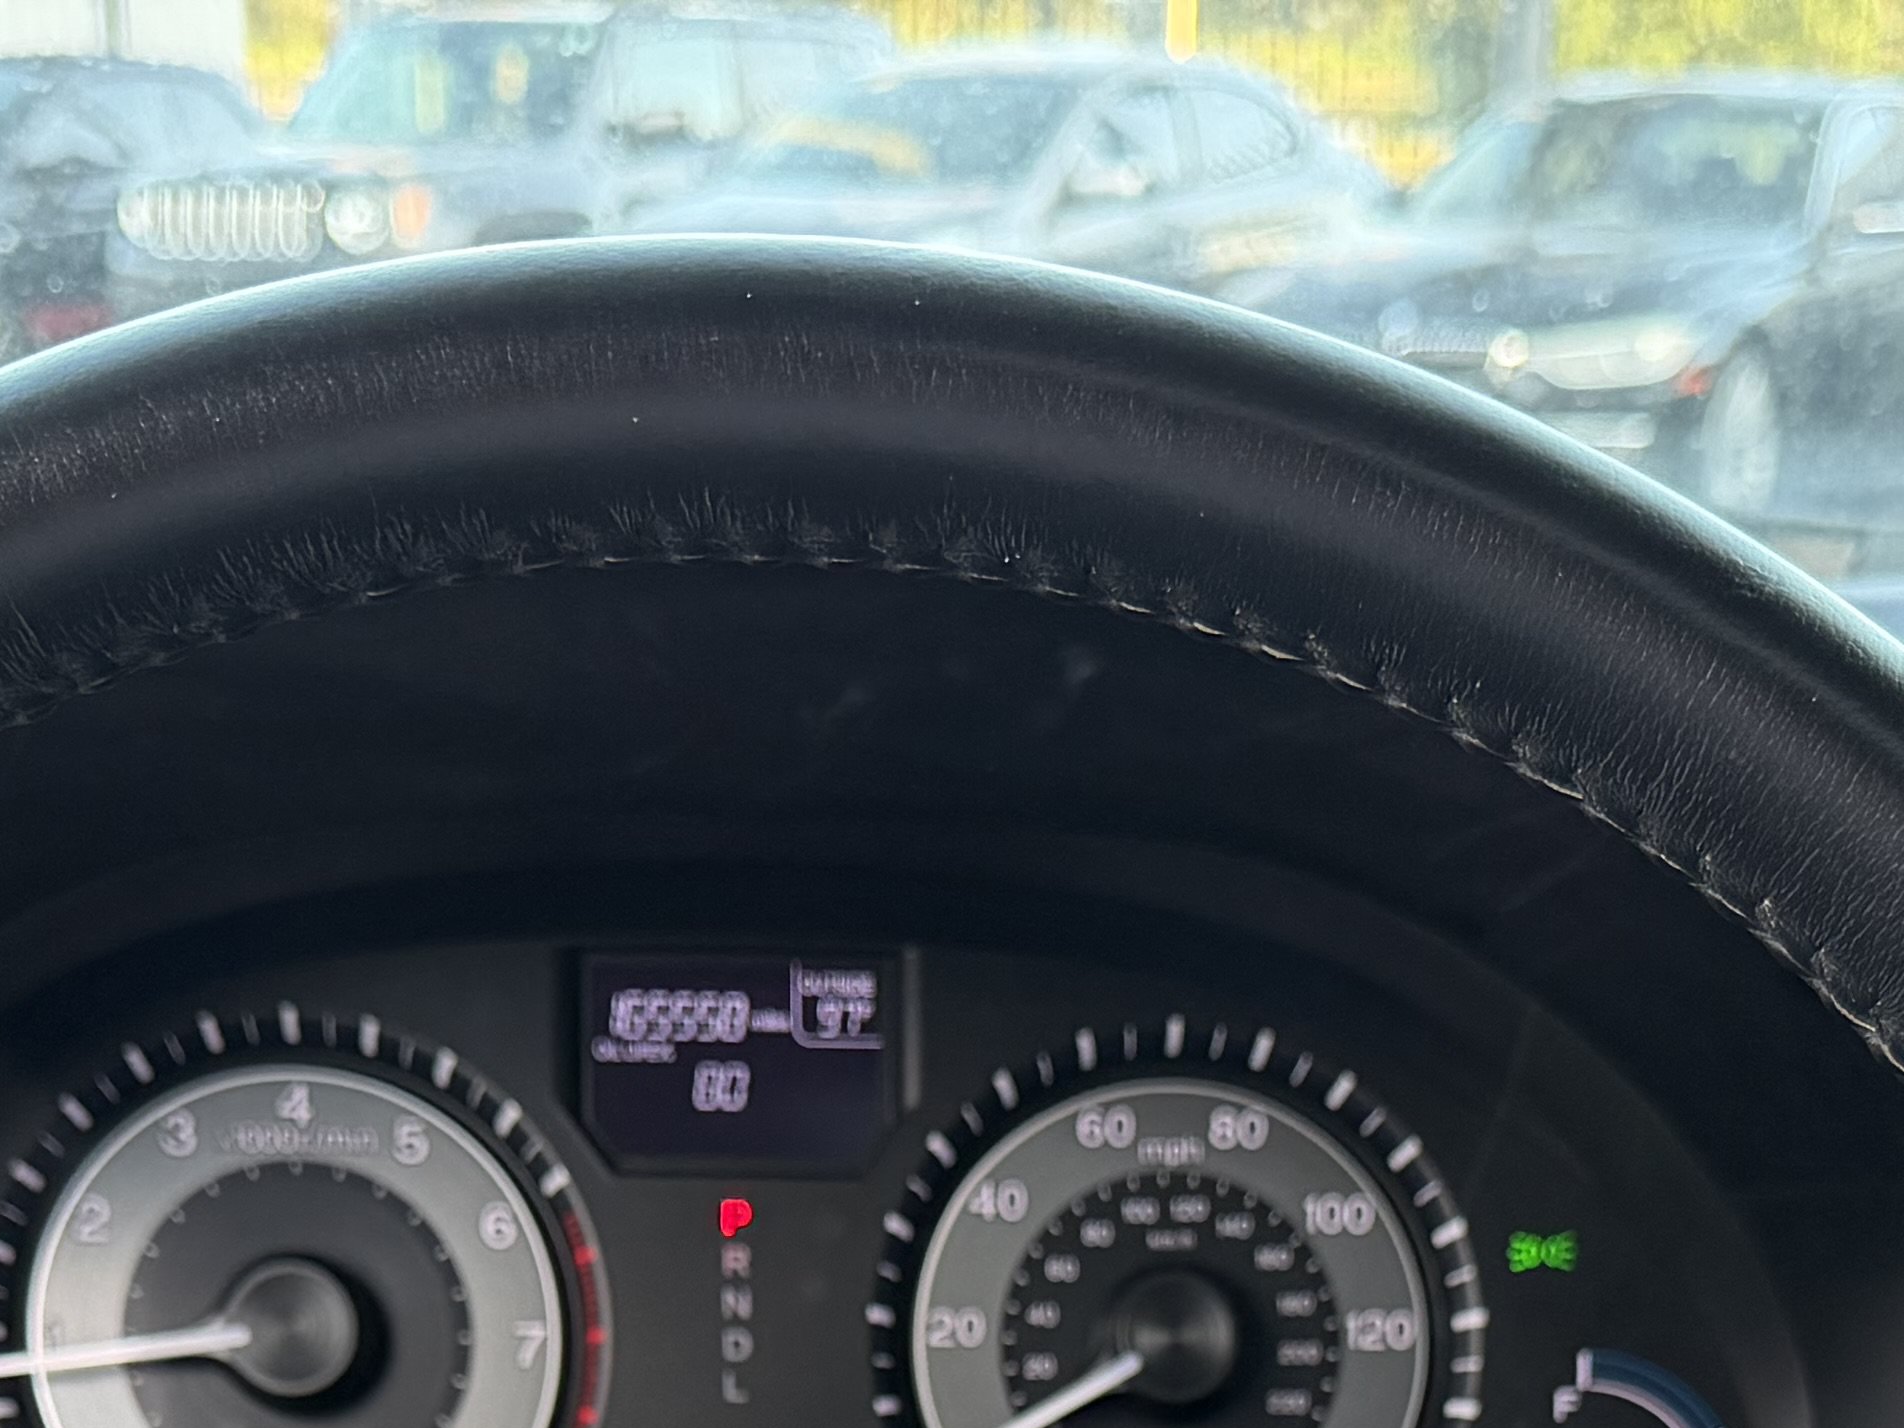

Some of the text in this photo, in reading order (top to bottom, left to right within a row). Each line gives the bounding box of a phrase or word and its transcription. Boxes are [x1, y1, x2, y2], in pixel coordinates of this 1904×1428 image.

[276, 1080, 314, 1127] 4
[155, 1110, 198, 1158] 3
[391, 1118, 431, 1167] 5
[1075, 1104, 1136, 1149] 60
[75, 1196, 112, 1244] 2
[478, 1200, 517, 1250] 6
[720, 1199, 753, 1237] P
[1303, 1192, 1376, 1236] 100
[720, 1283, 753, 1321] N
[514, 1319, 551, 1369] 7
[721, 1326, 754, 1362] D
[927, 1305, 987, 1348] 20
[1345, 1308, 1417, 1352] 120
